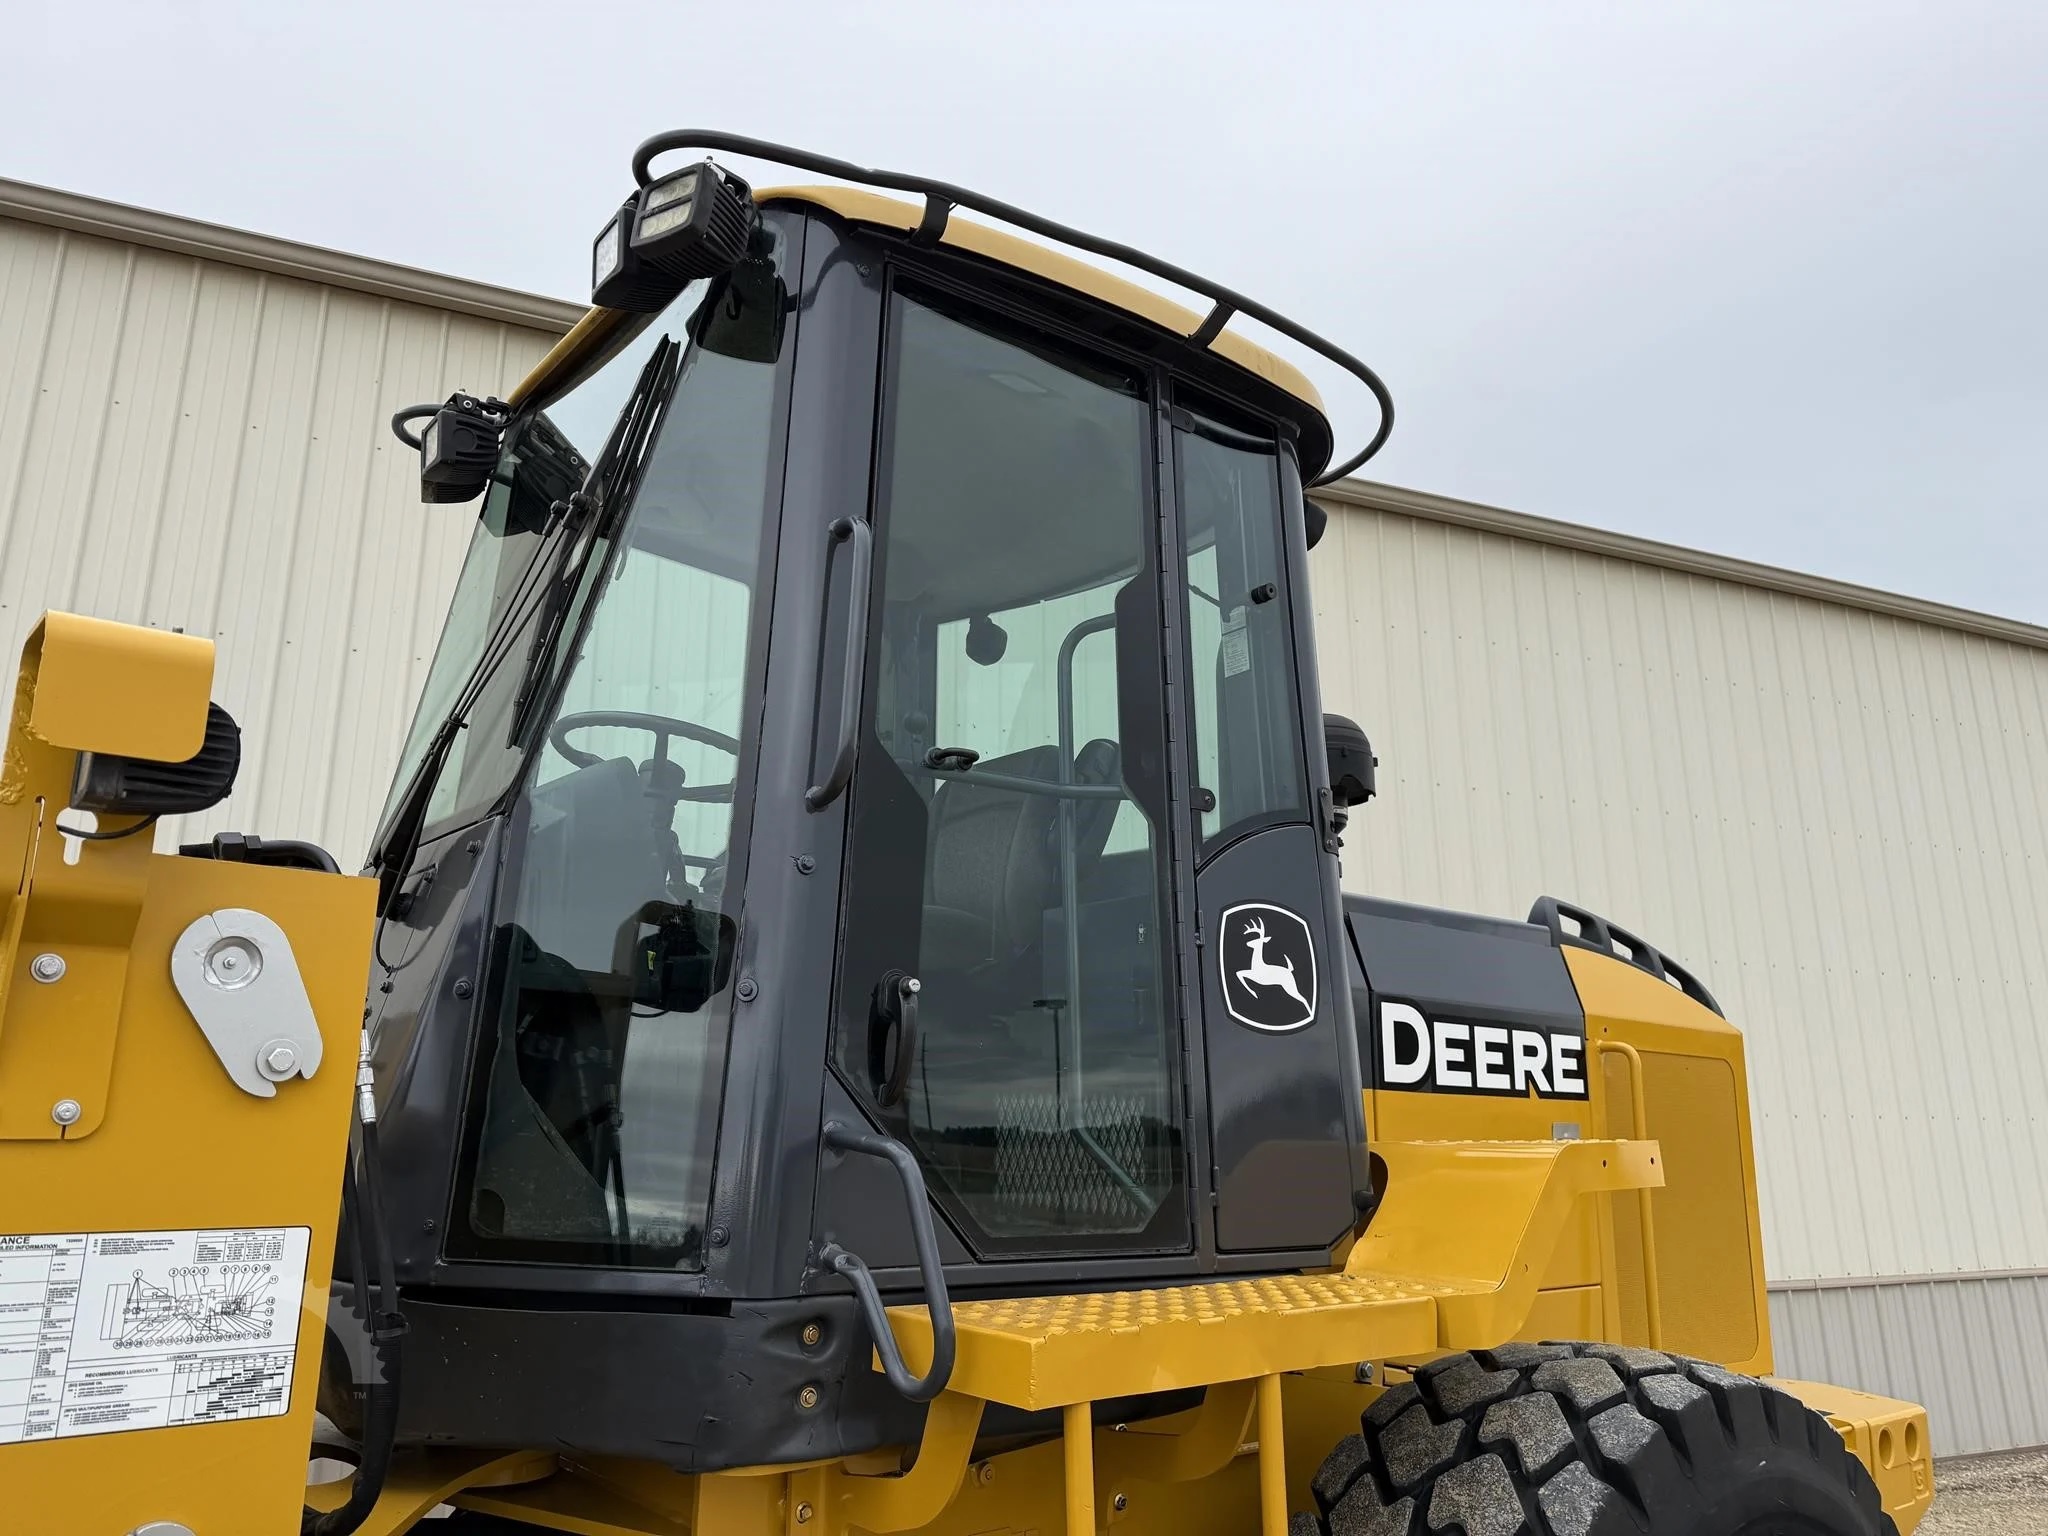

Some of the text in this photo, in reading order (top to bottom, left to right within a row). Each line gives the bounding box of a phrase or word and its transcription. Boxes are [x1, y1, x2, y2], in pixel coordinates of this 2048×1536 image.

[1381, 1001, 1585, 1093] DEERE
[1, 1236, 30, 1244] ANCE
[85, 1370, 125, 1378] RECOMMENDED
